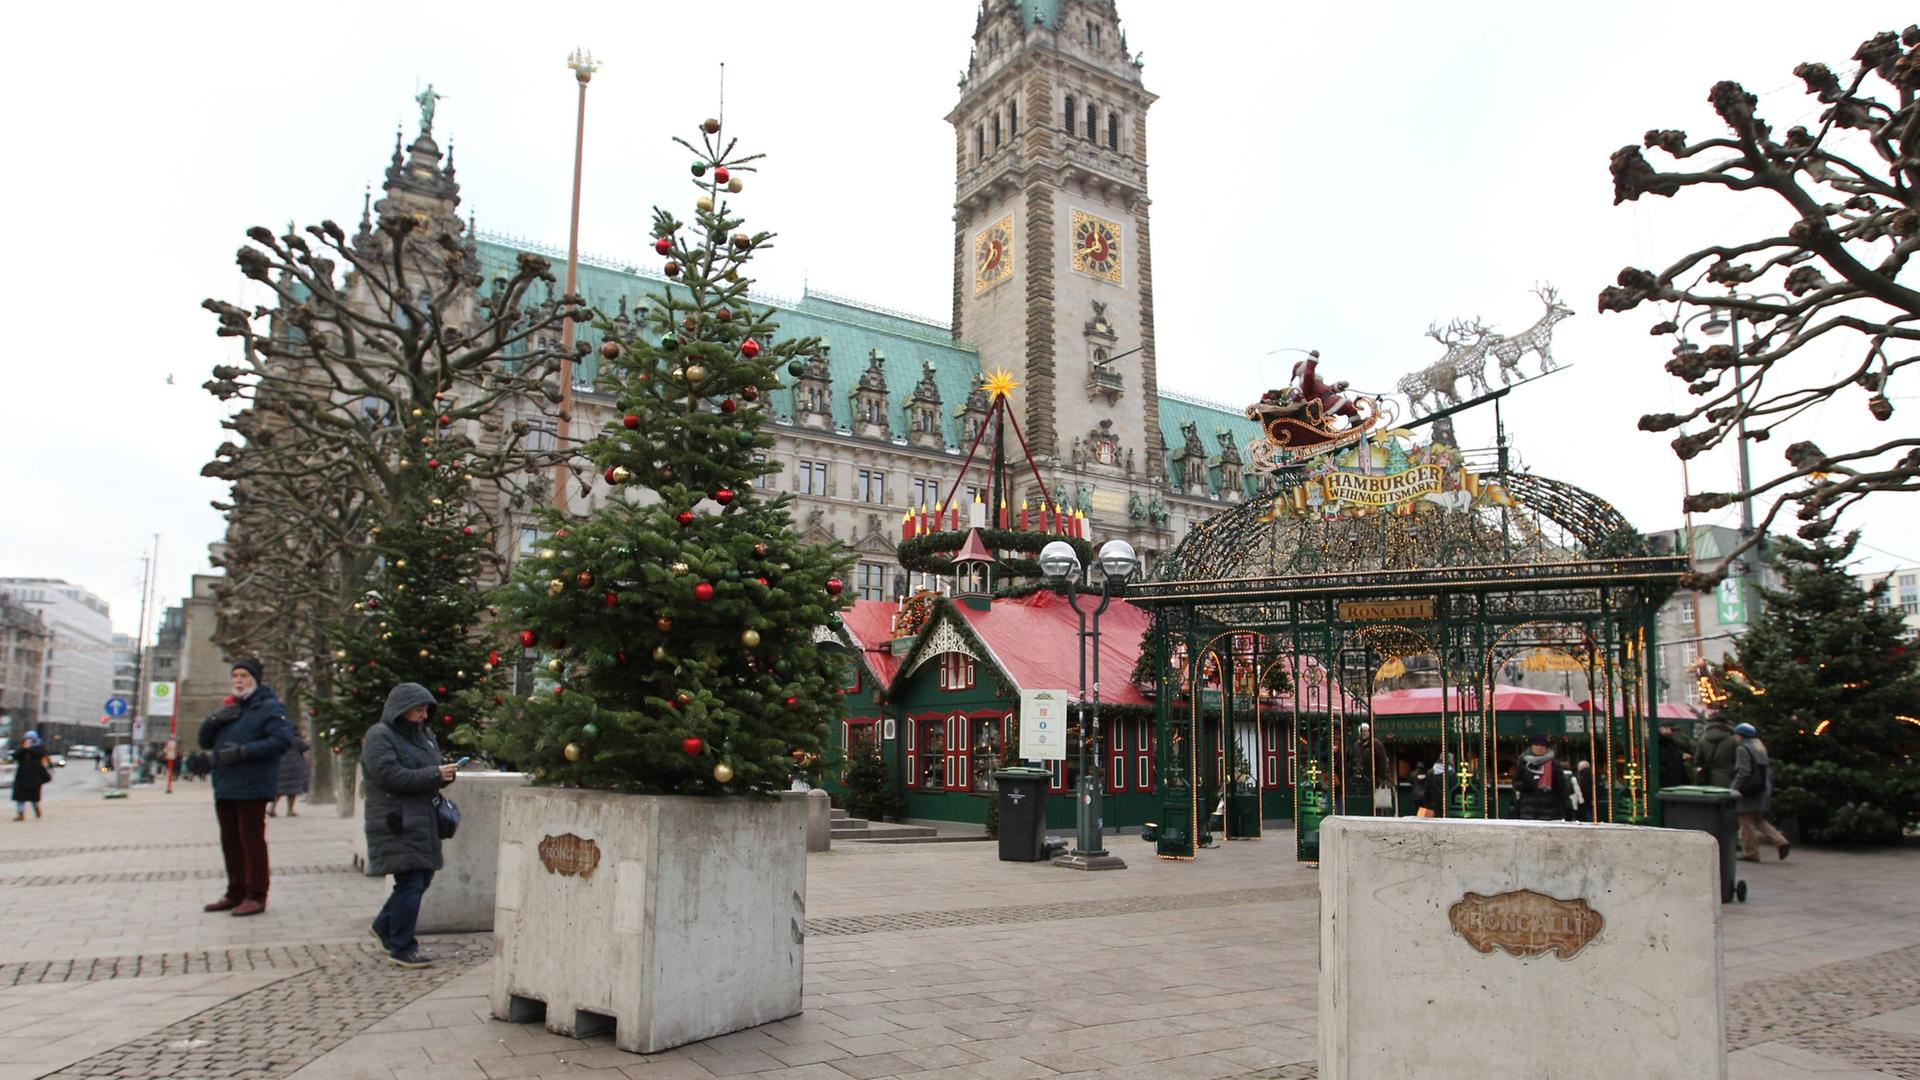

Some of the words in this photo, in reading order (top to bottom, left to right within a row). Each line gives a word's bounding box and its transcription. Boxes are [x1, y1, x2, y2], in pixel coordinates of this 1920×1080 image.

[1327, 466, 1440, 492] HAMBURGER
[1329, 481, 1440, 503] WEIHNACHTSMARKT
[1348, 604, 1424, 617] RONCALLI
[546, 847, 594, 862] RONC
[1470, 911, 1582, 935] RONCALLI
